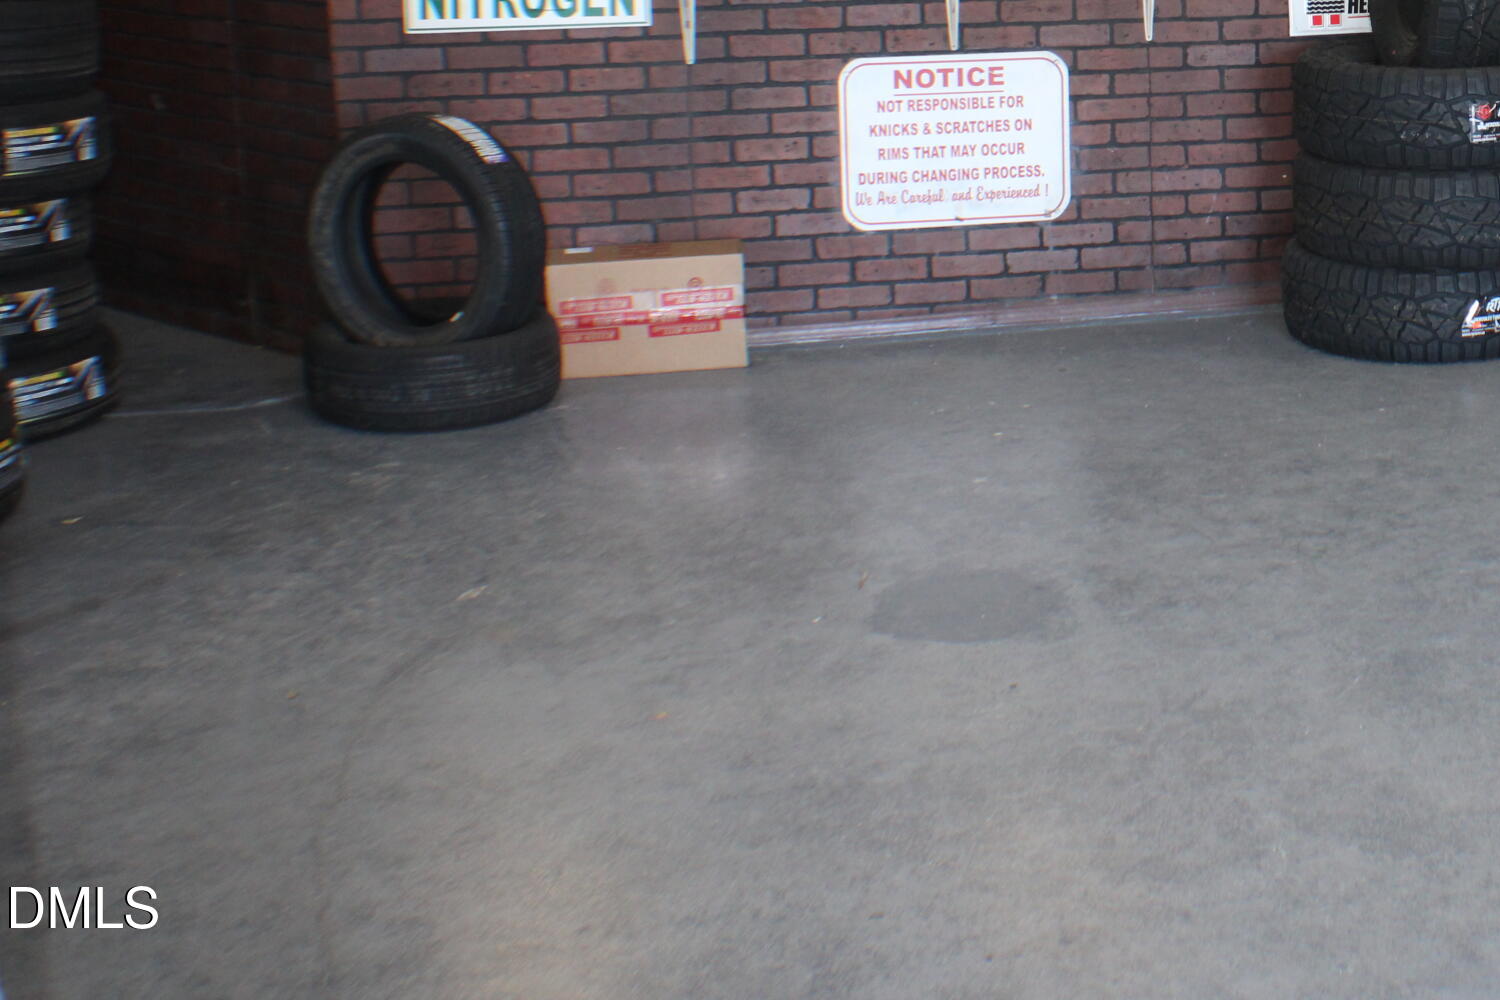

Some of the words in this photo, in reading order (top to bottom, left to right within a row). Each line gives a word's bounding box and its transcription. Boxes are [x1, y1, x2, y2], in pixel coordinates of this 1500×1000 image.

[893, 66, 1005, 89] NOTICE
[877, 100, 902, 113] NOT
[907, 97, 994, 111] RESPONSIBLE
[999, 95, 1024, 109] FOR
[869, 122, 918, 137] KNICKS
[923, 122, 931, 135] &
[936, 120, 1010, 135] SCRATCHES
[1014, 119, 1032, 131] ON
[878, 147, 909, 161] RIMS
[913, 145, 947, 159] THAT
[951, 144, 977, 157] MAY
[981, 142, 1025, 156] OCCUR
[858, 171, 908, 185] DURING
[912, 167, 979, 182] CHANGING
[984, 165, 1044, 180] PROCESS.
[855, 191, 872, 206] We
[877, 191, 896, 205] Are
[901, 189, 944, 204] Careful
[952, 187, 972, 201] and
[976, 184, 1040, 200] Experienced
